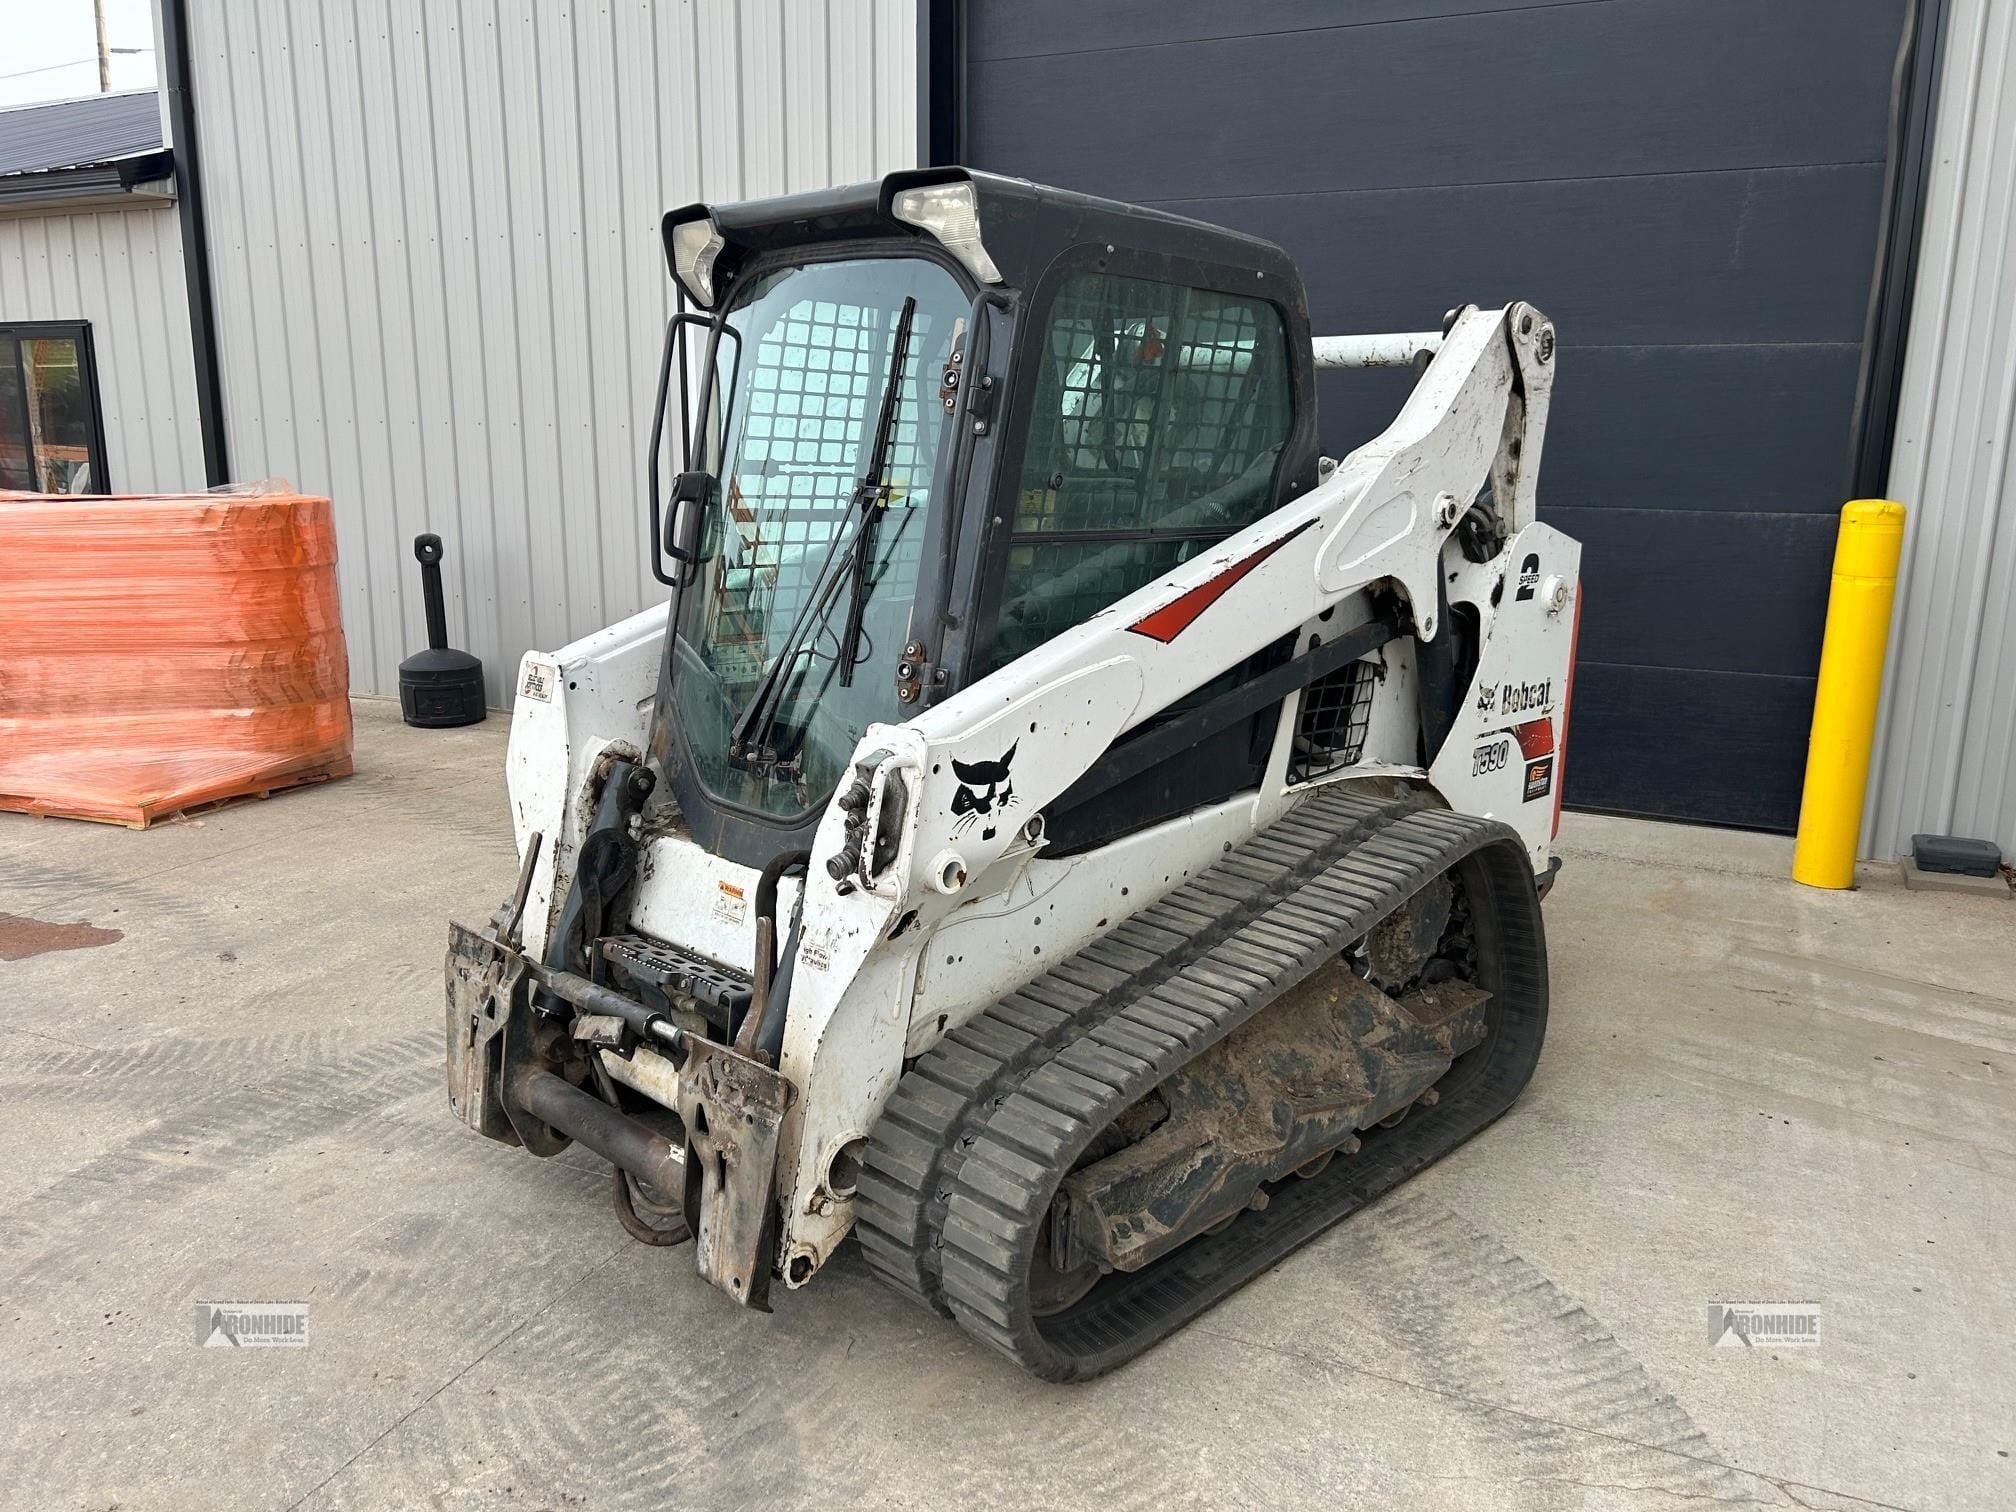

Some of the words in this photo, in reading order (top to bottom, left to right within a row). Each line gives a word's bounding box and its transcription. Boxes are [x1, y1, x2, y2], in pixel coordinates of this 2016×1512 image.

[1515, 553, 1539, 601] 2
[1518, 574, 1540, 585] SPEED
[1501, 677, 1551, 715] Bobcat
[1472, 740, 1509, 777] T590
